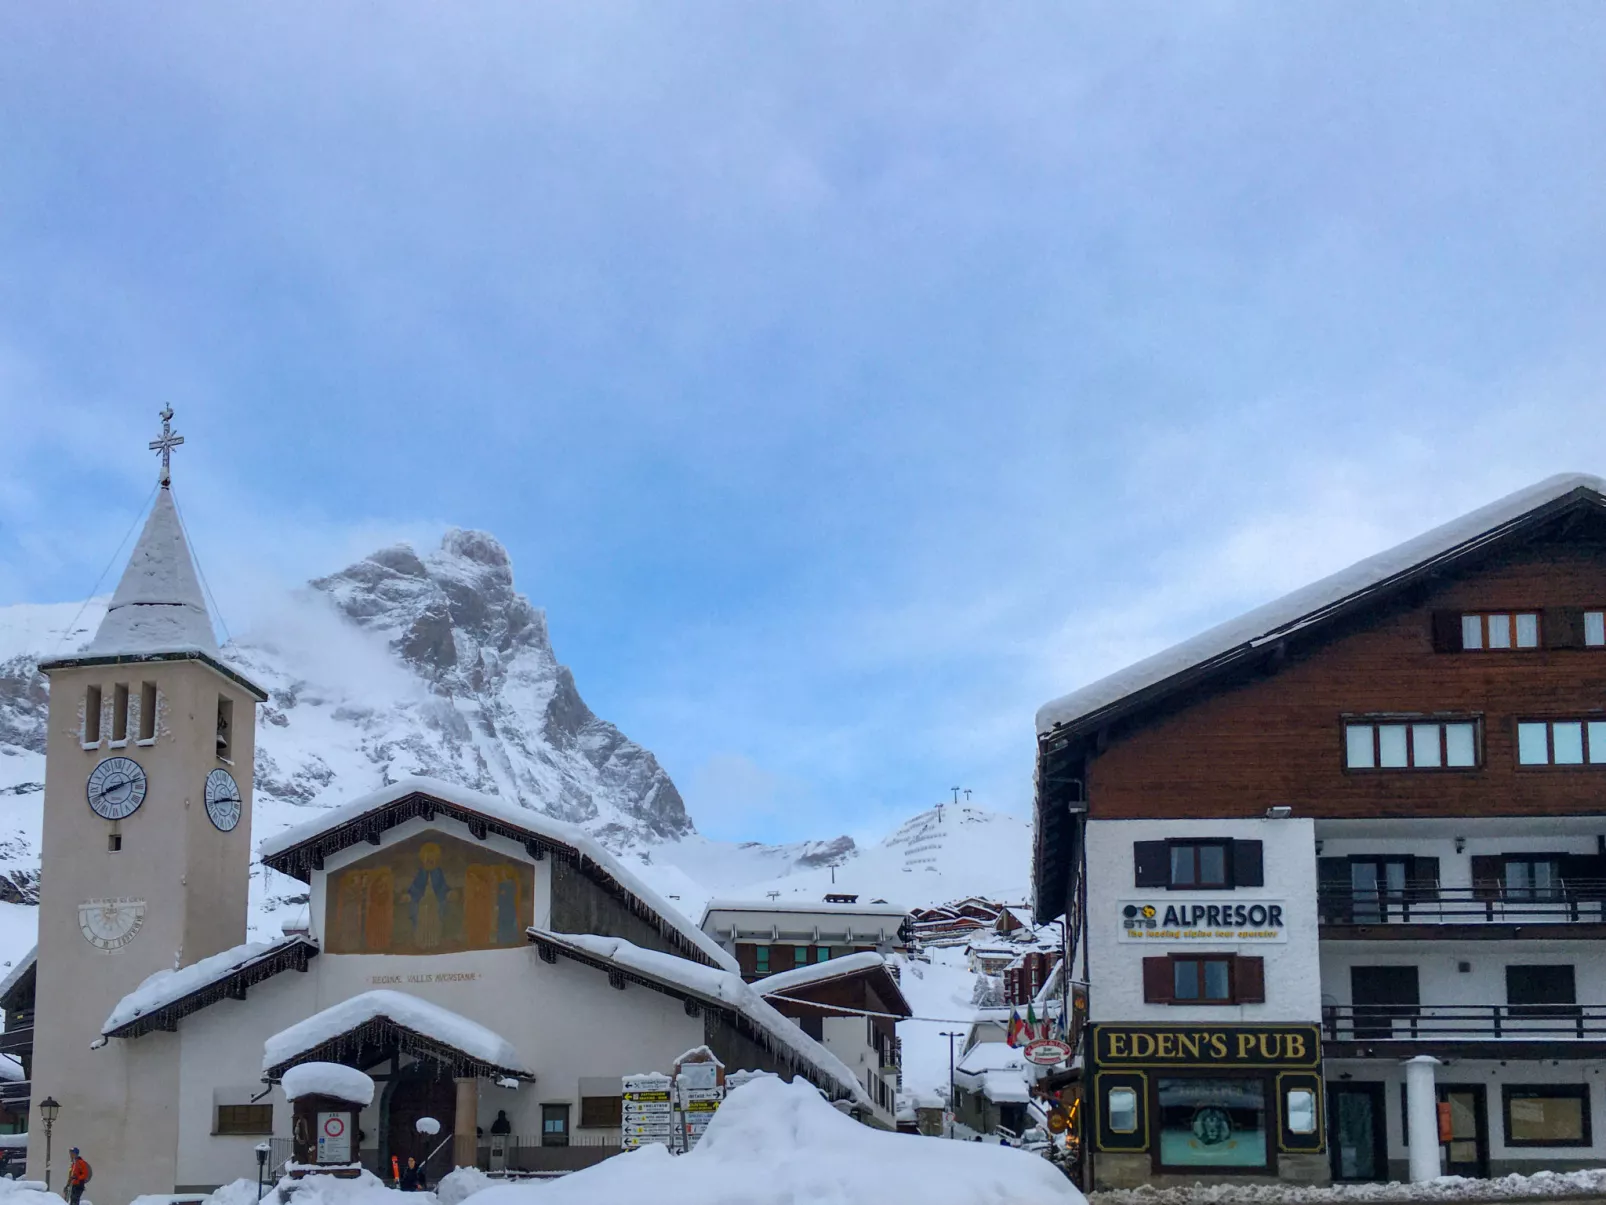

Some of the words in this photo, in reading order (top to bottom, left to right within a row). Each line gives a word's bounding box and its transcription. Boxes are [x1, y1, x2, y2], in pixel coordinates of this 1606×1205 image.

[1162, 904, 1284, 927] ALPRESOR
[1127, 929, 1143, 938] The
[1146, 929, 1181, 939] leading
[1107, 1032, 1228, 1058] EDEN'S
[1236, 1033, 1306, 1058] PUB
